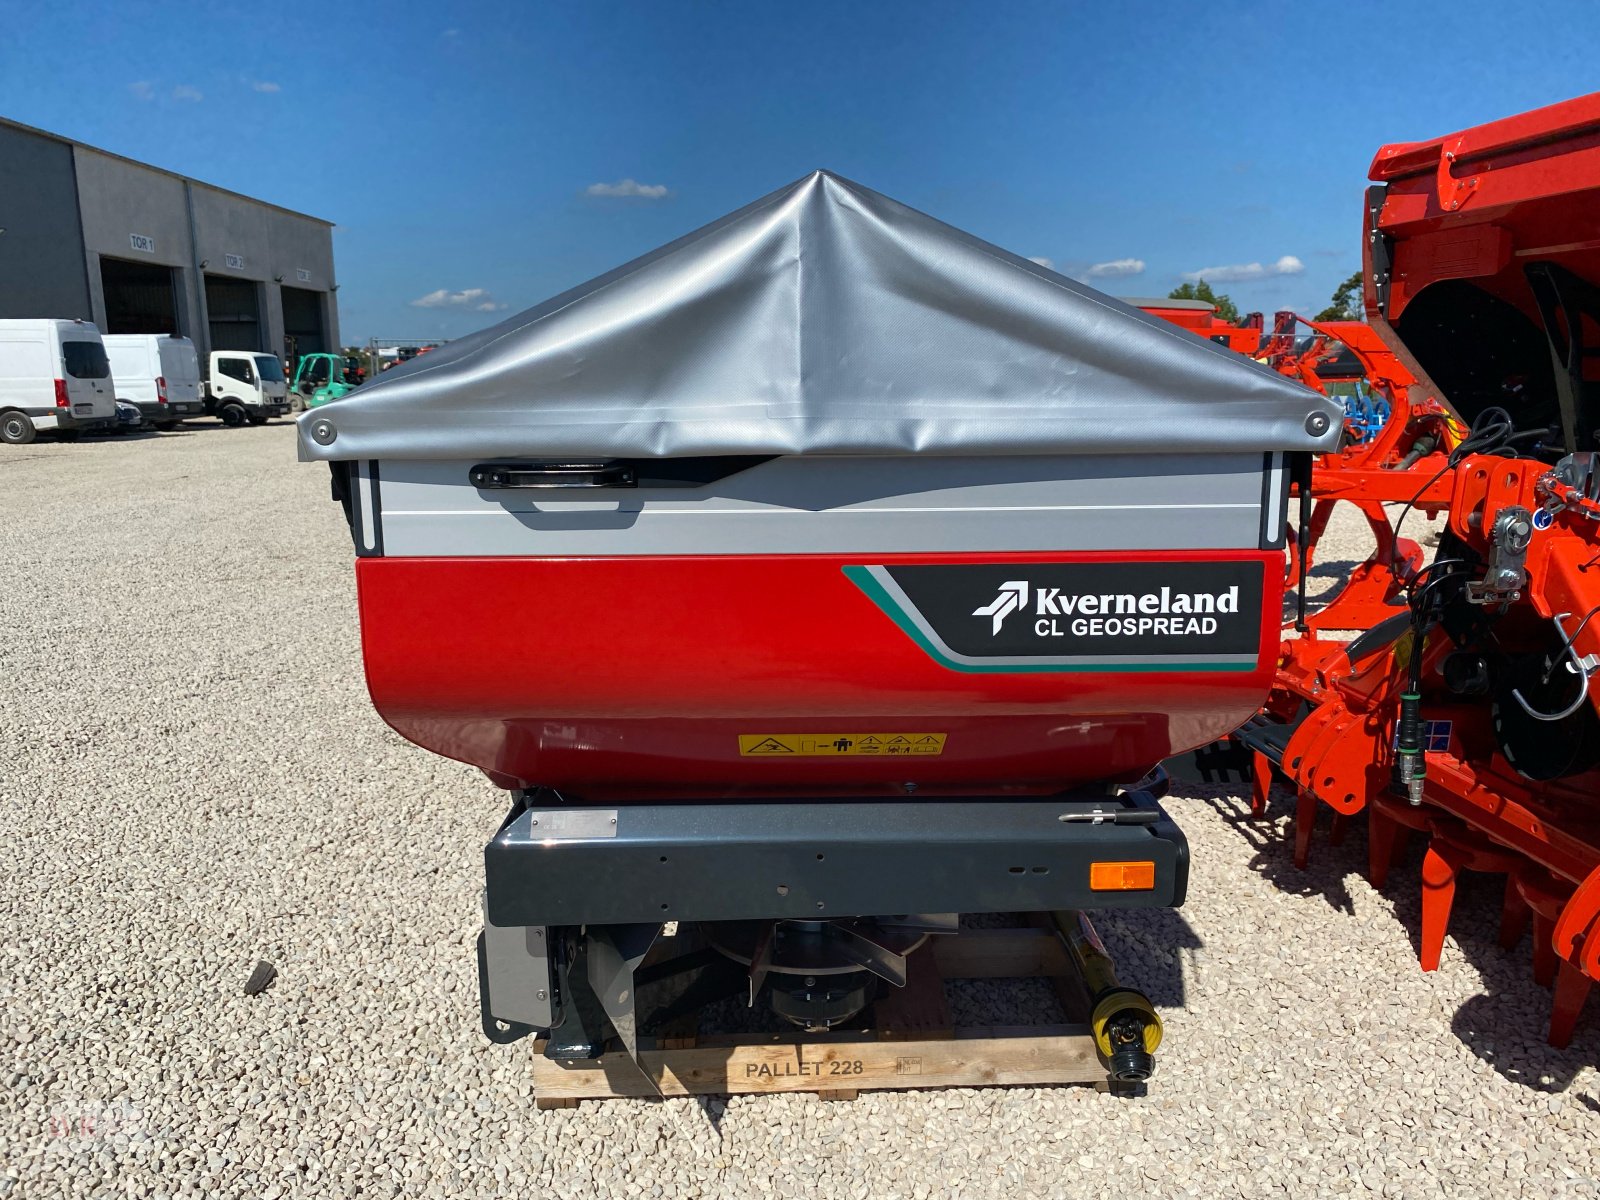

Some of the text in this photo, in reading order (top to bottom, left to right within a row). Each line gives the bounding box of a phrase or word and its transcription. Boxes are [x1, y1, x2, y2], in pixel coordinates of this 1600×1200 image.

[131, 235, 148, 250] TOR
[226, 255, 238, 267] TOR
[1036, 585, 1239, 615] Kverneland
[1035, 617, 1218, 637] CL GEOSPREAD
[746, 1060, 864, 1078] PALLET 228
